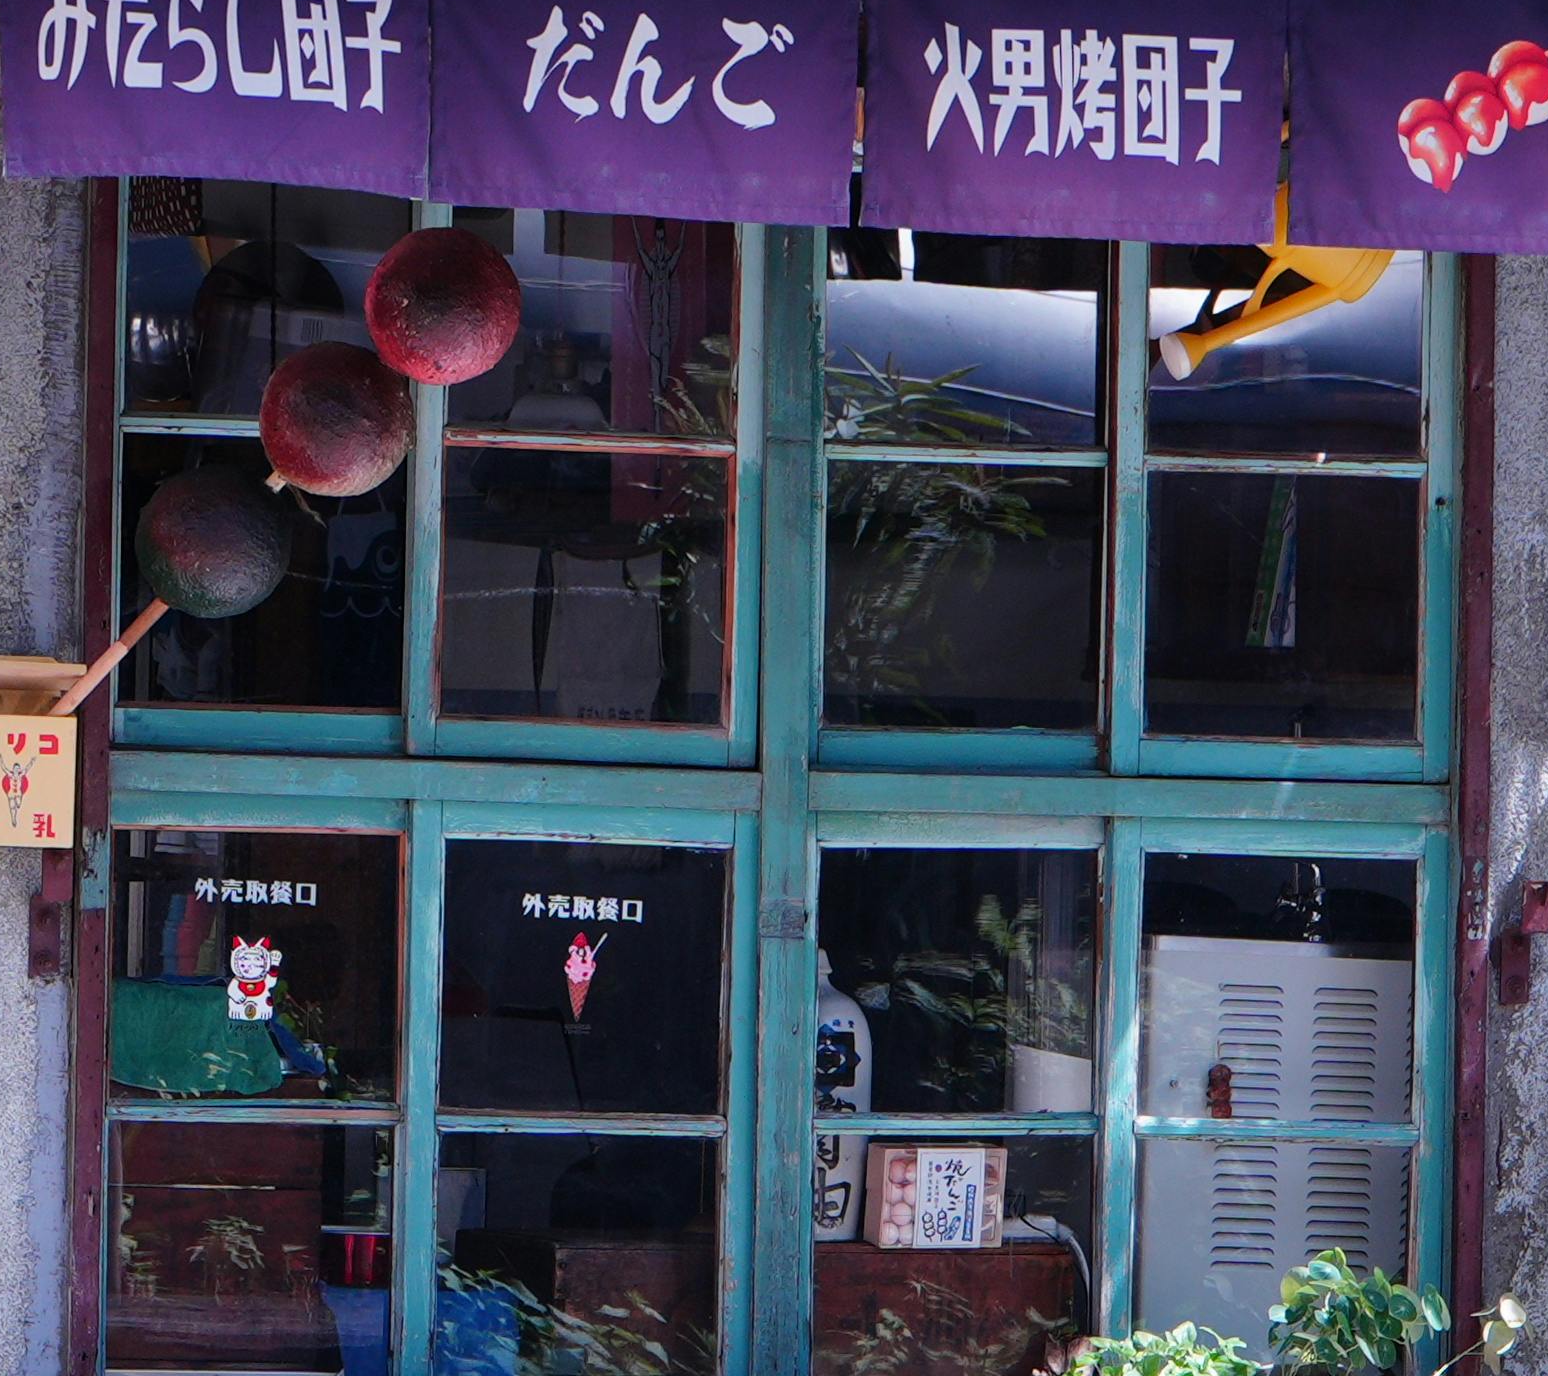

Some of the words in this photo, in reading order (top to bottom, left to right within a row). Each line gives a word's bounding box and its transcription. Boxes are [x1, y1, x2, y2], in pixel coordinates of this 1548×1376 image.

[524, 4, 796, 131] だんご
[194, 877, 318, 908] 外売取餐口
[521, 891, 644, 924] 外売取餐口
